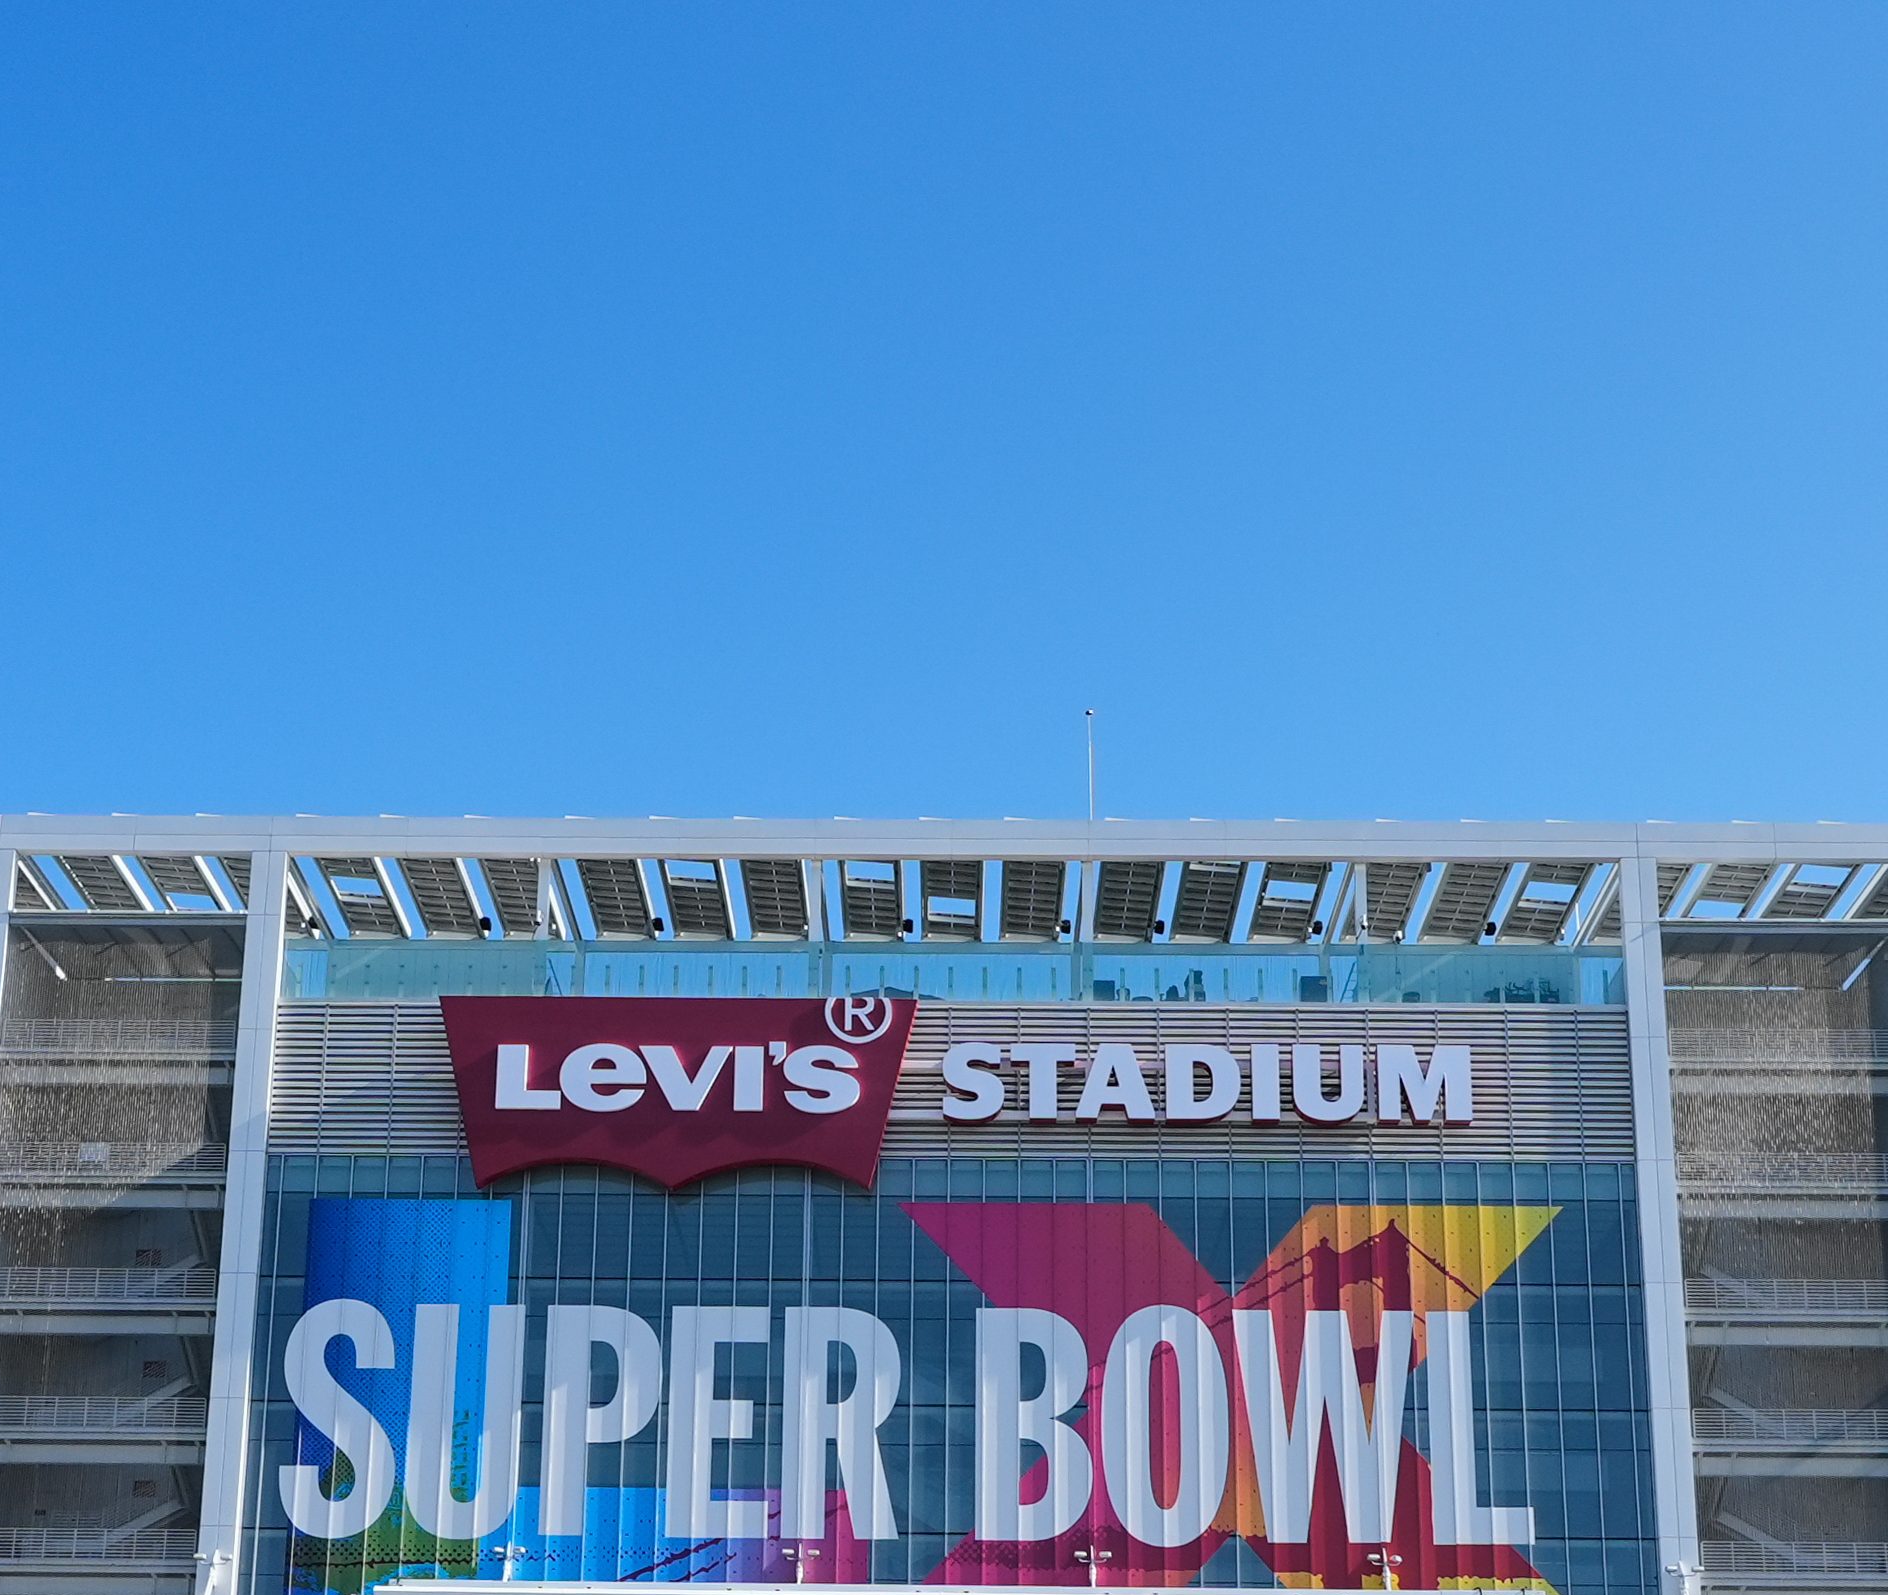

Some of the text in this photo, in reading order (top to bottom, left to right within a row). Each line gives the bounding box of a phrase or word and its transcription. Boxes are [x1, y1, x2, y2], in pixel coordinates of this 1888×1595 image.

[942, 1042, 1474, 1126] STADIUM
[278, 1299, 1536, 1547] SUPER BOWL
